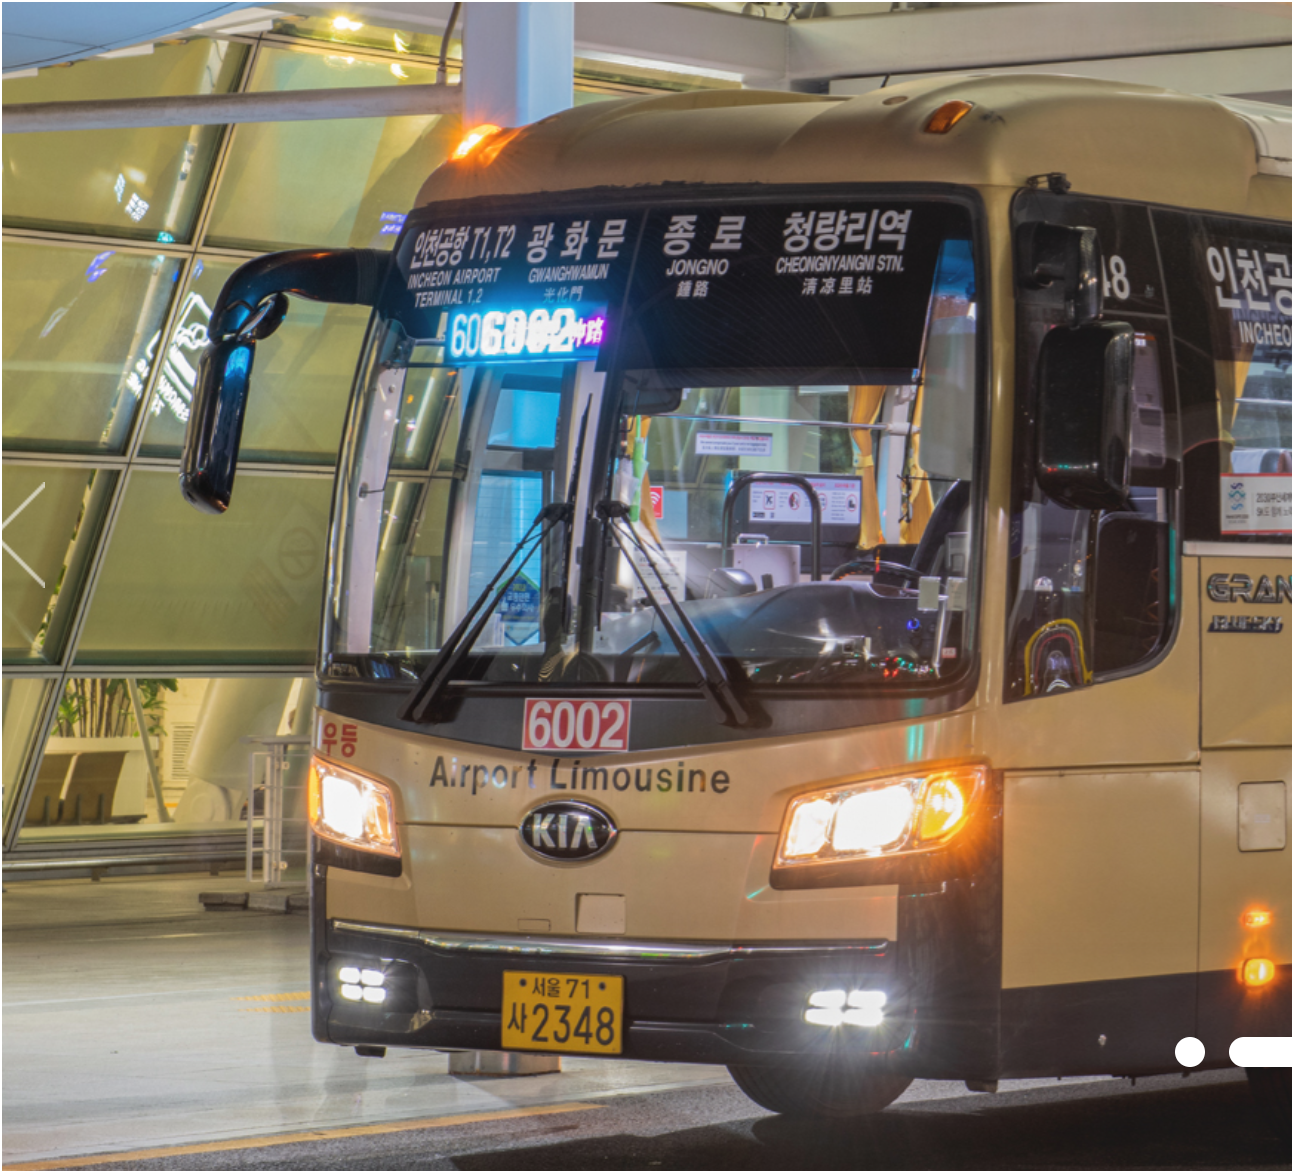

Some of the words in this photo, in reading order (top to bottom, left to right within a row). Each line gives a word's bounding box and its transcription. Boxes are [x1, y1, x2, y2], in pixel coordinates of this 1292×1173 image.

[410, 225, 470, 269] 인천공항
[469, 223, 517, 264] T1,T2
[526, 218, 628, 264] 광화문
[662, 214, 747, 256] 종로
[782, 209, 913, 253] 청량리역
[407, 271, 452, 290] INCHEON
[452, 267, 502, 286] AIRPORT
[528, 263, 611, 284] GWANGHWAMUN
[665, 258, 730, 277] JONGNO
[776, 254, 875, 275] CHEONGNYANGNI
[876, 254, 906, 274] STN.
[414, 289, 463, 308] TERMINAL
[467, 287, 484, 306] 1,2
[322, 722, 358, 758] 우등
[528, 700, 625, 749] 6002
[429, 755, 538, 796] Airport
[549, 757, 731, 794] Limousine
[532, 813, 598, 850] KIA
[532, 977, 561, 998] 서울
[565, 978, 590, 999] 71
